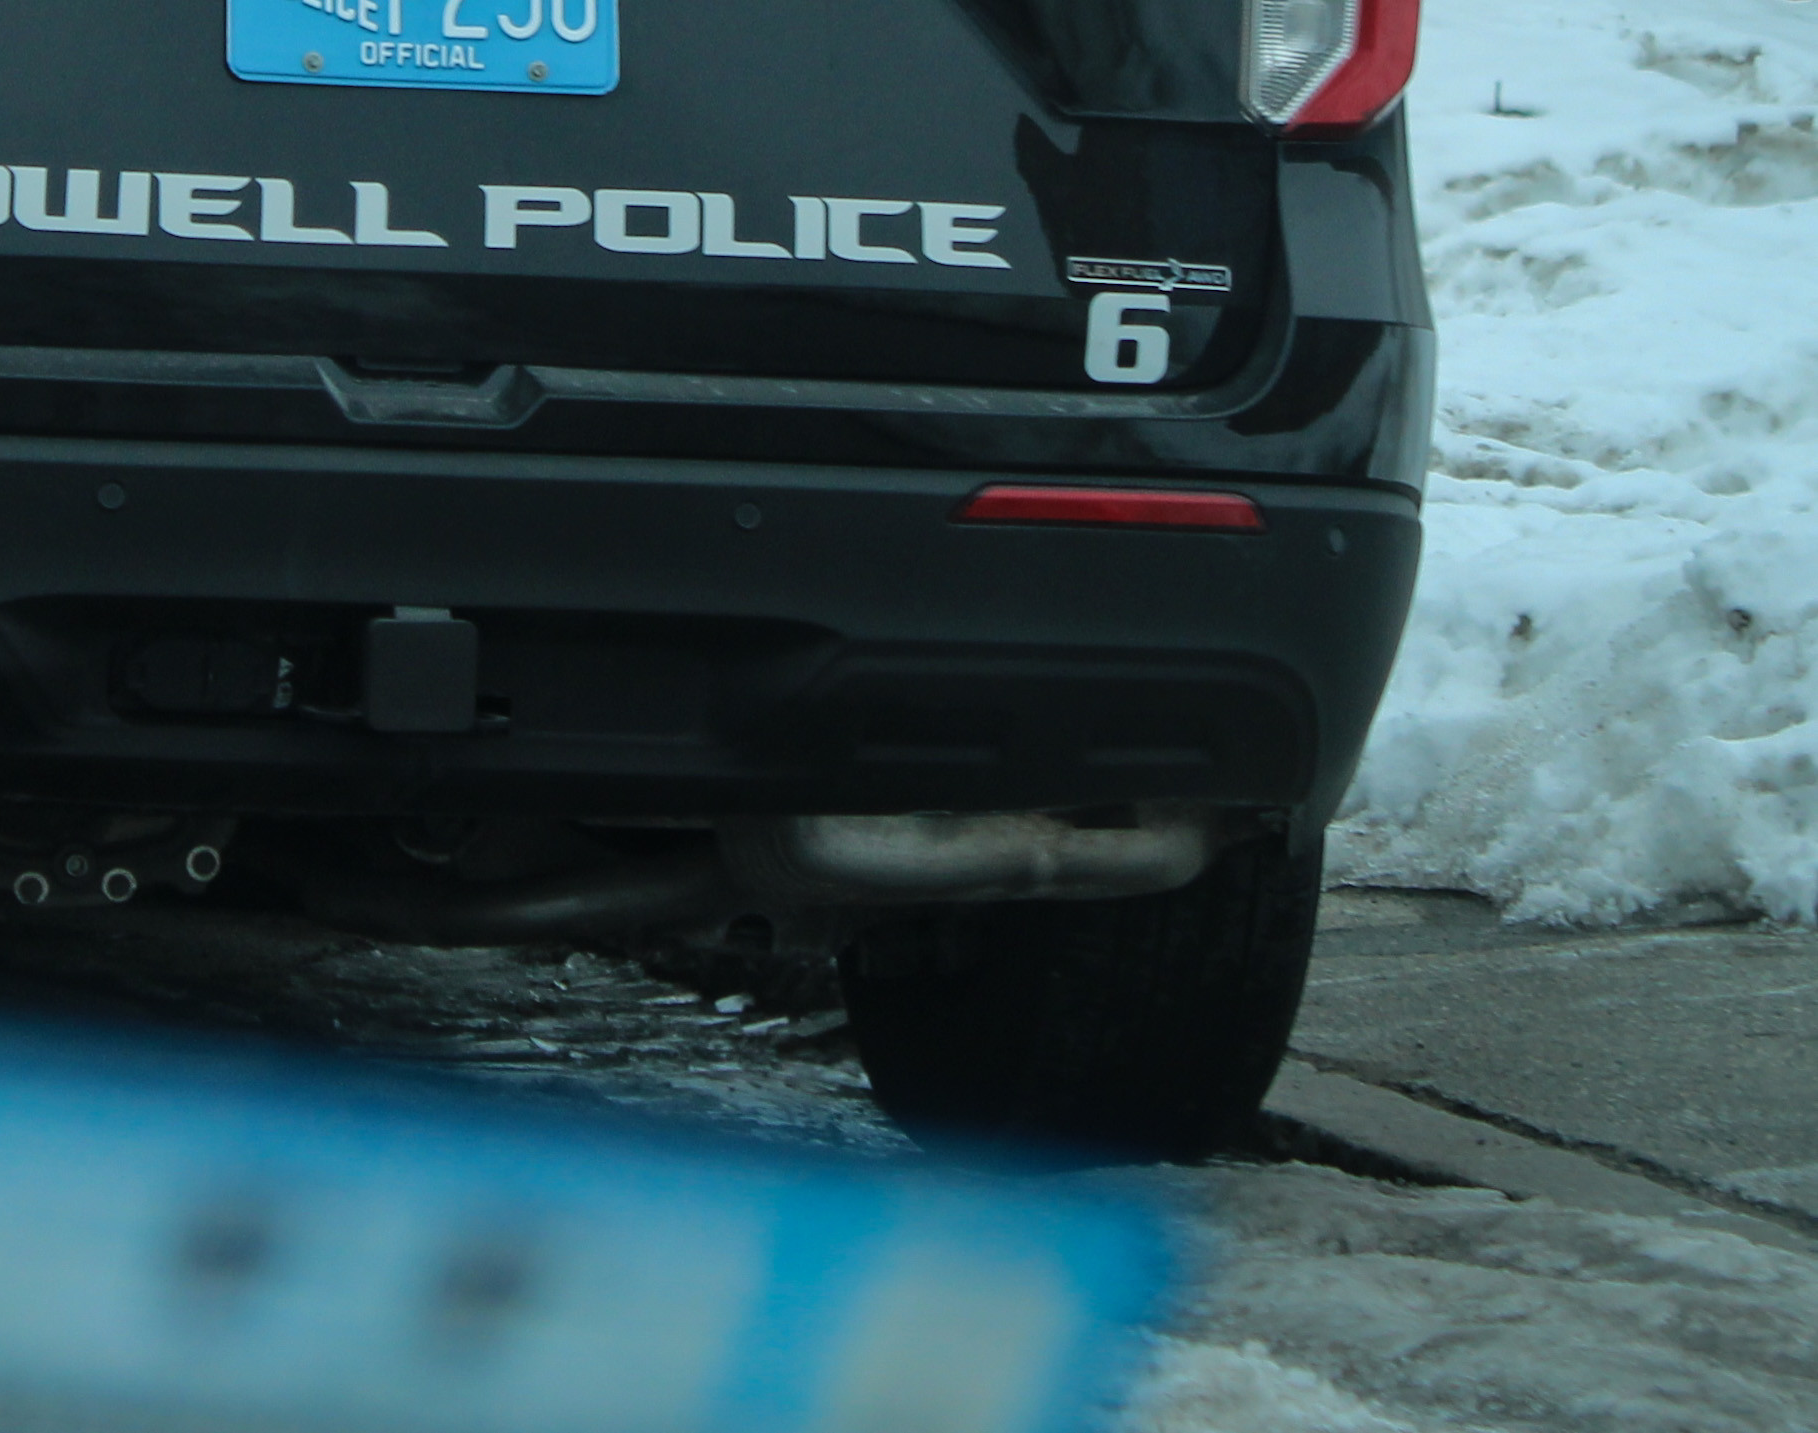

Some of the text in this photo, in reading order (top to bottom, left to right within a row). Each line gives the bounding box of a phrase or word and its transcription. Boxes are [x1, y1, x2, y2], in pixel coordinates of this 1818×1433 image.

[359, 41, 485, 70] OFFICIAL
[477, 184, 1012, 269] POLICE
[1084, 291, 1171, 385] 6
